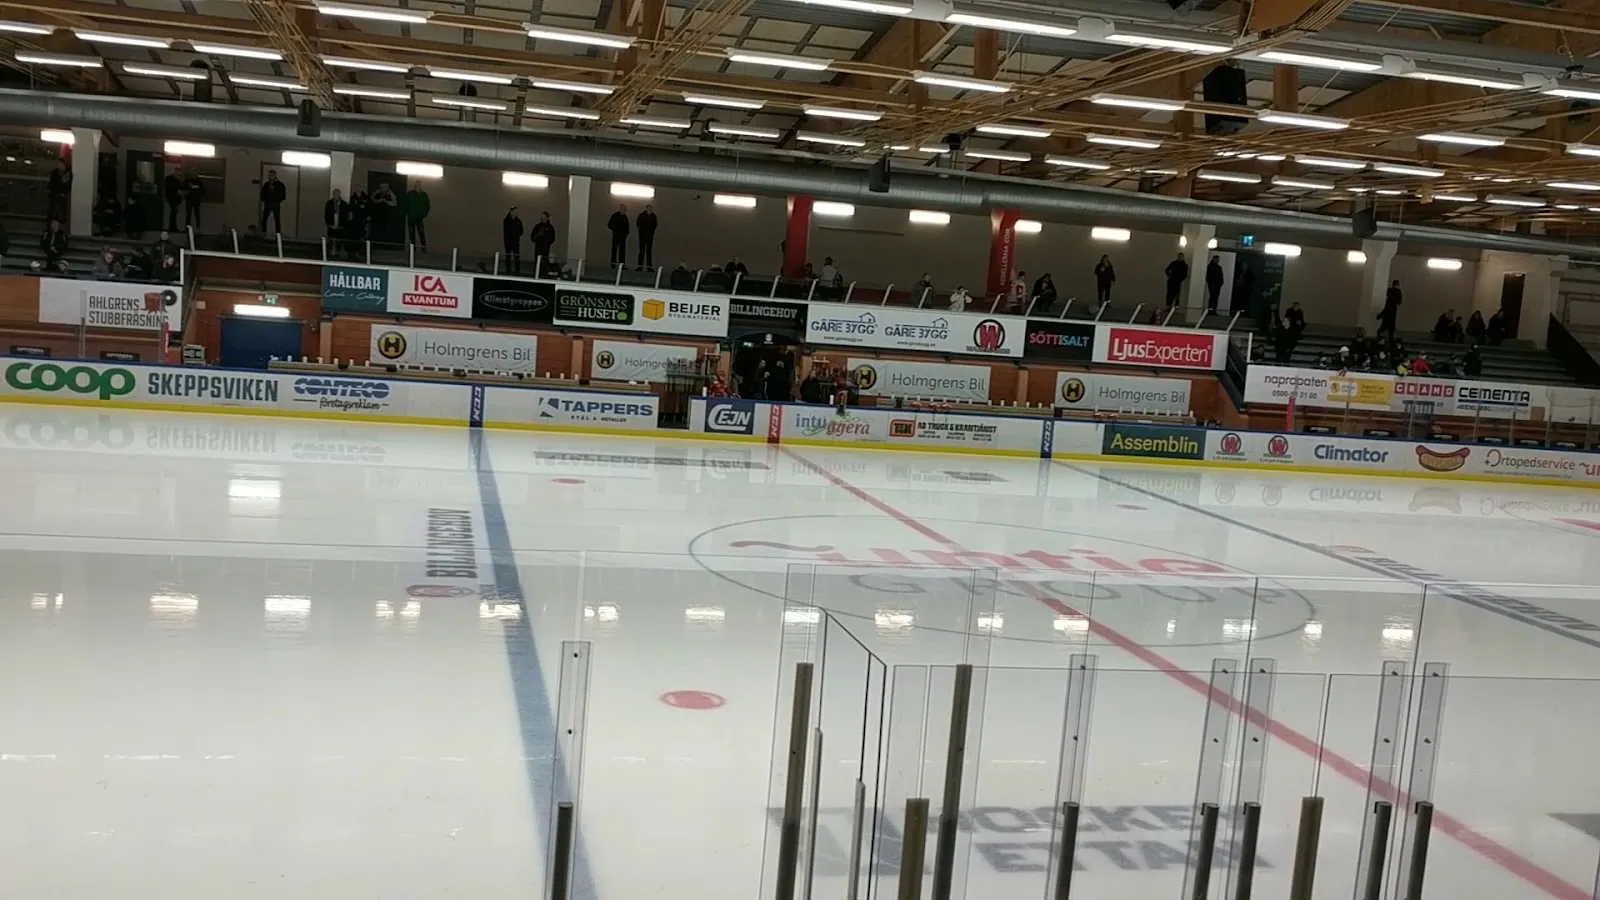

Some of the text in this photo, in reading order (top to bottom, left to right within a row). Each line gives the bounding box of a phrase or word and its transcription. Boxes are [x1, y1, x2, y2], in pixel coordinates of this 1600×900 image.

[329, 271, 381, 290] HÅLLBAR
[414, 275, 447, 293] ICA
[89, 295, 139, 311] AHLGRENS
[404, 295, 457, 306] KVANTUM
[560, 294, 627, 310] GRÖNSAKS
[669, 302, 721, 316] BEIJER
[578, 307, 618, 321] HUSET
[730, 304, 798, 319] BILLINGEHOV
[424, 341, 531, 361] Holmgrens Bil
[1113, 338, 1209, 363] LjusExperten
[625, 357, 680, 372] Holmgre
[5, 362, 136, 400] coop
[148, 373, 279, 401] SKEPPSVIKEN
[294, 378, 390, 398] CONTECO
[892, 373, 985, 391] Holmgrens Bil
[1395, 383, 1454, 397] CRAMO
[1099, 387, 1185, 403] Holmgrens Bil
[1459, 387, 1530, 402] CEMENTA
[562, 400, 653, 416] TAPPERS
[708, 404, 751, 430] CEJN
[1110, 432, 1198, 454] Assemblin
[1314, 444, 1389, 463] Climator
[1486, 448, 1576, 471] Ortopedservice
